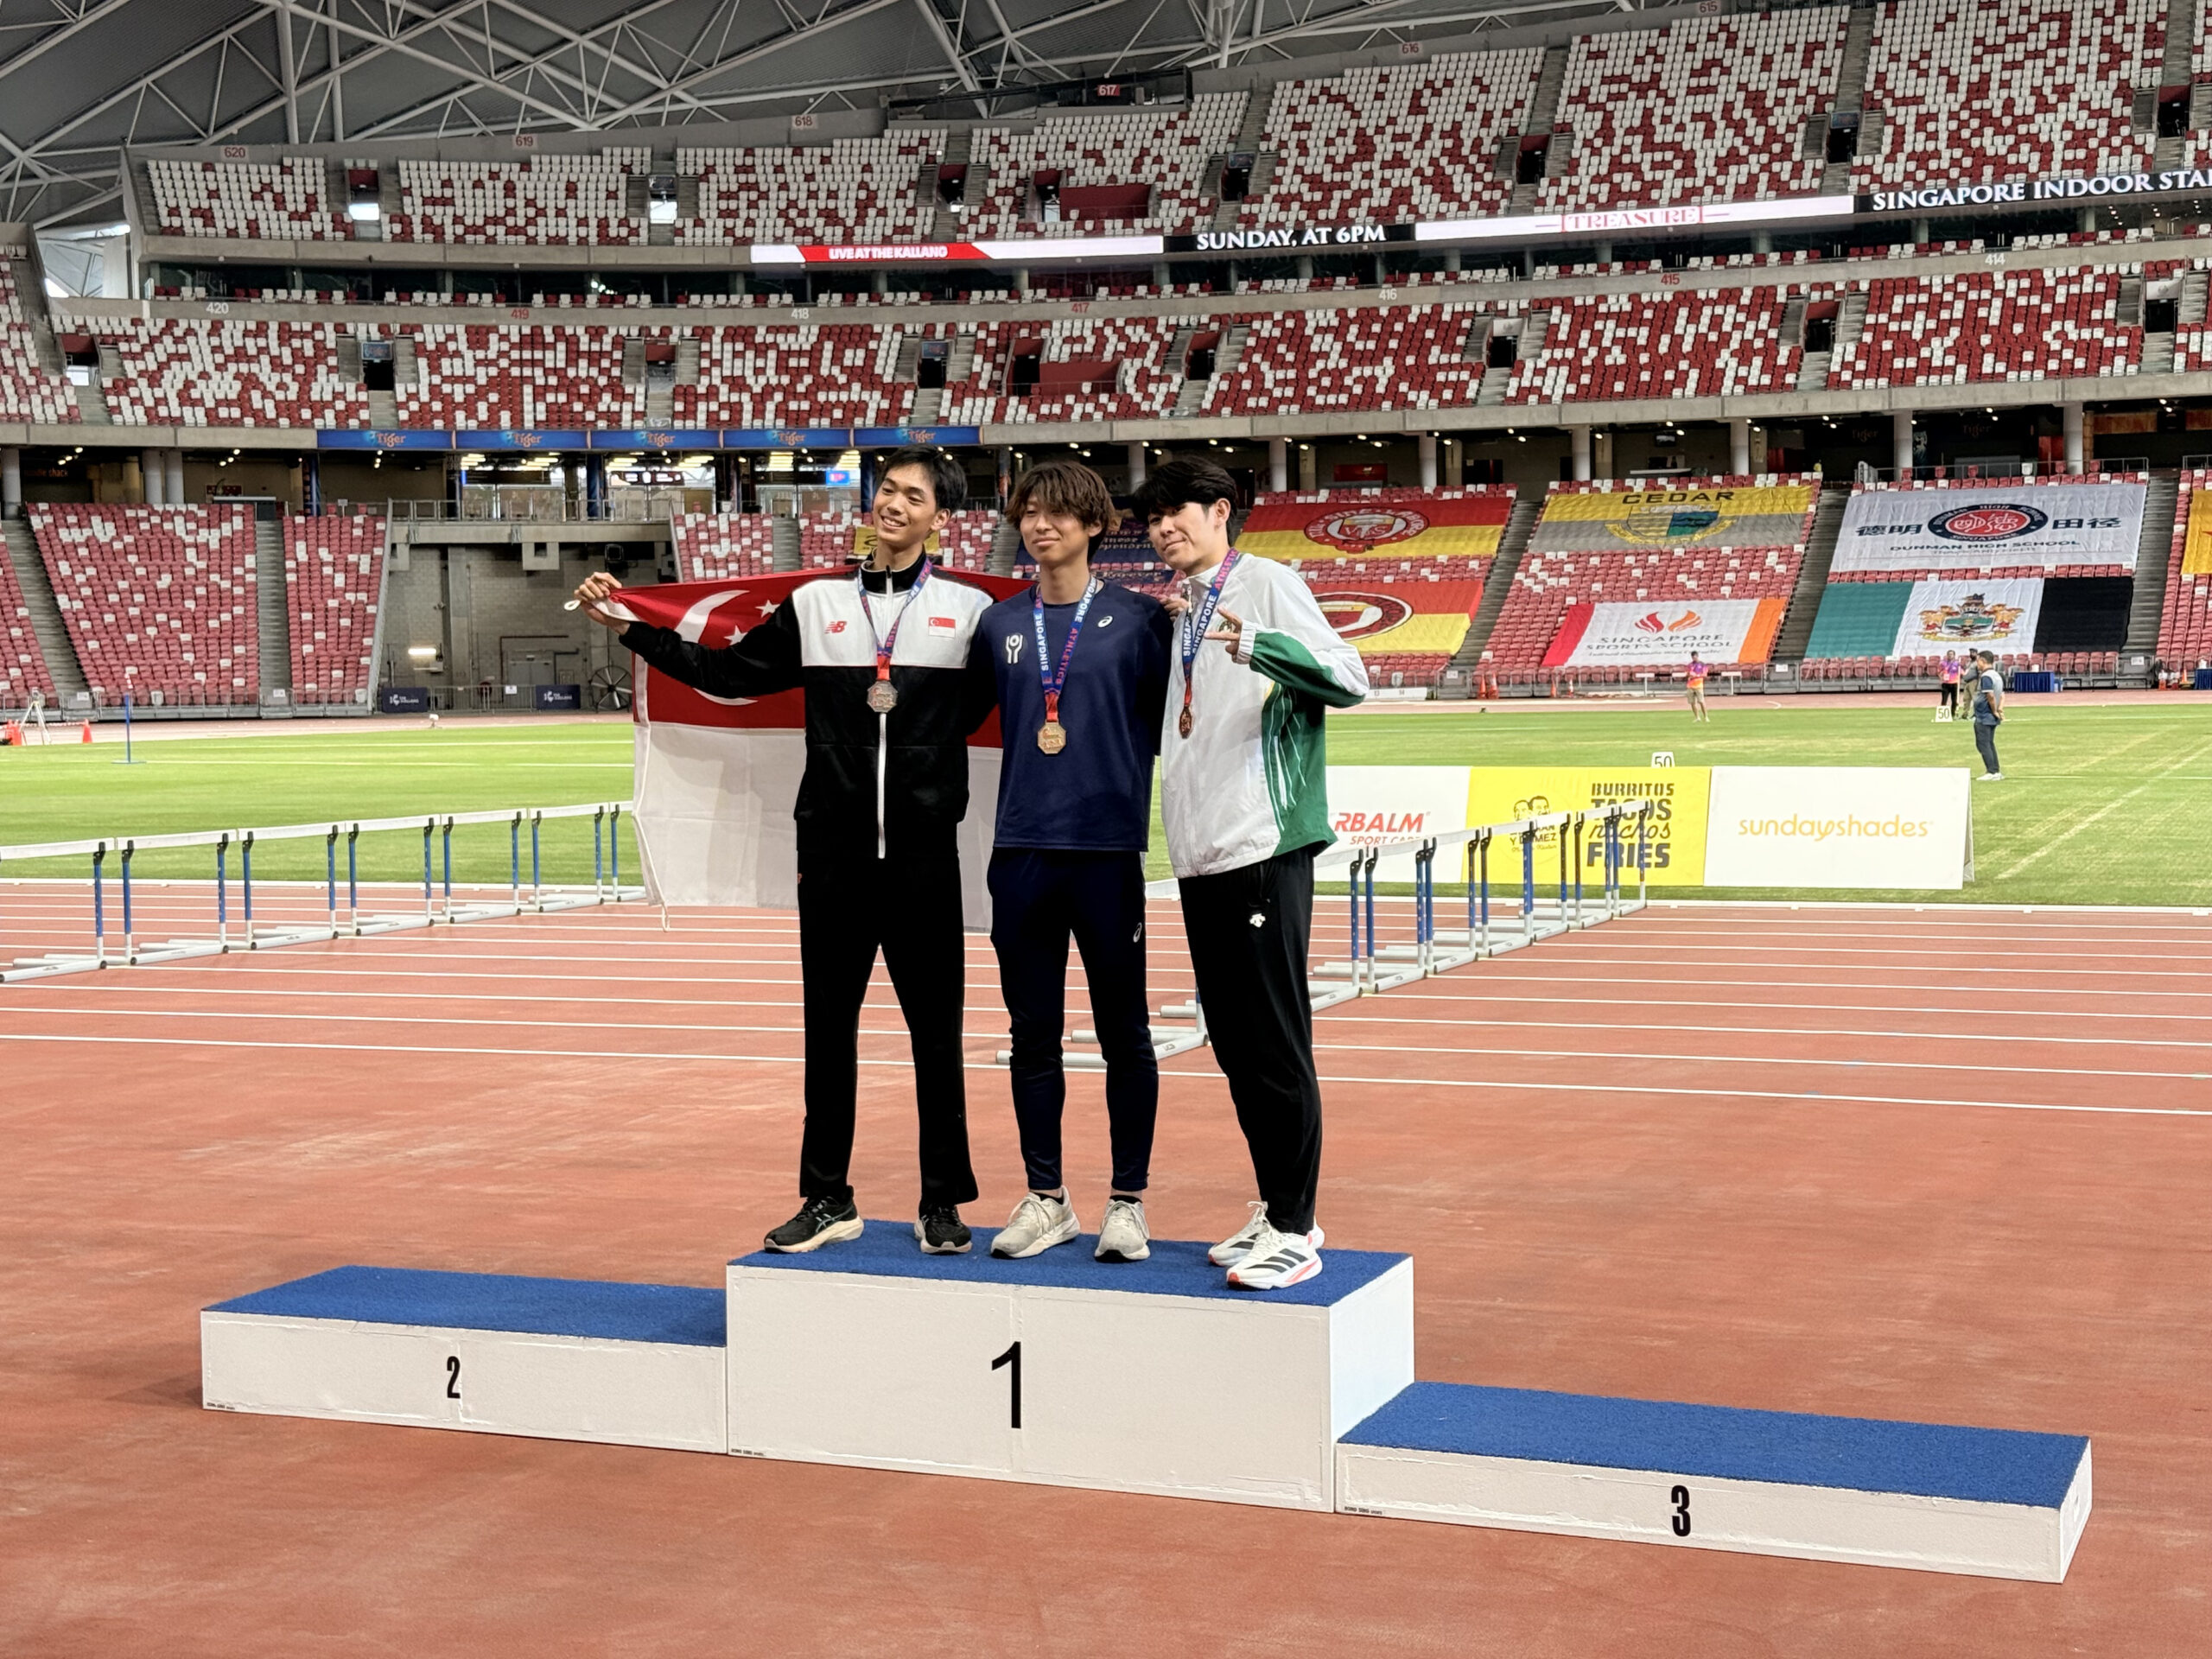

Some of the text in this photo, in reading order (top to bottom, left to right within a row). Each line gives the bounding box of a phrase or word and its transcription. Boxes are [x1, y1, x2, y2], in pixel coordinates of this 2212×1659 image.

[1700, 2, 1718, 13] 615
[1402, 43, 1420, 54] 616
[1098, 84, 1116, 95] 617
[795, 115, 812, 127] 618
[516, 136, 534, 147] 619
[225, 147, 245, 158] 620
[1872, 168, 2212, 212] SINGAPORE INDOOR STA
[1567, 207, 1696, 230] TREASURE
[1197, 224, 1388, 251] SUNDAY, AT 6PM
[829, 245, 949, 259] LIVE AT THE KALLANG
[1985, 253, 2005, 265] 414
[1661, 273, 1680, 285] 415
[1379, 289, 1397, 301] 416
[206, 302, 228, 314] 420
[511, 309, 529, 320] 419
[791, 308, 809, 320] 418
[1071, 302, 1090, 313] 417
[377, 433, 405, 447] Tiger
[513, 433, 542, 447] Tiger
[646, 433, 676, 447] Tiger
[778, 432, 806, 446] Tiger
[908, 429, 937, 443] Tiger
[1621, 491, 1735, 505] CEDAR
[1074, 577, 1097, 623] INGAPORE
[1033, 613, 1049, 671] SINGAPORE
[1600, 634, 1724, 644] SINGAPORE
[1937, 708, 1950, 720] 50
[1655, 755, 1672, 767] 50
[1591, 783, 1675, 797] BURRITOS
[1333, 812, 1425, 833] RBALM
[1738, 813, 1929, 842] sundayshades
[1350, 836, 1388, 845] SPORT
[446, 1356, 461, 1399] 2
[990, 1340, 1021, 1429] 1
[1670, 1484, 1692, 1537] 3
